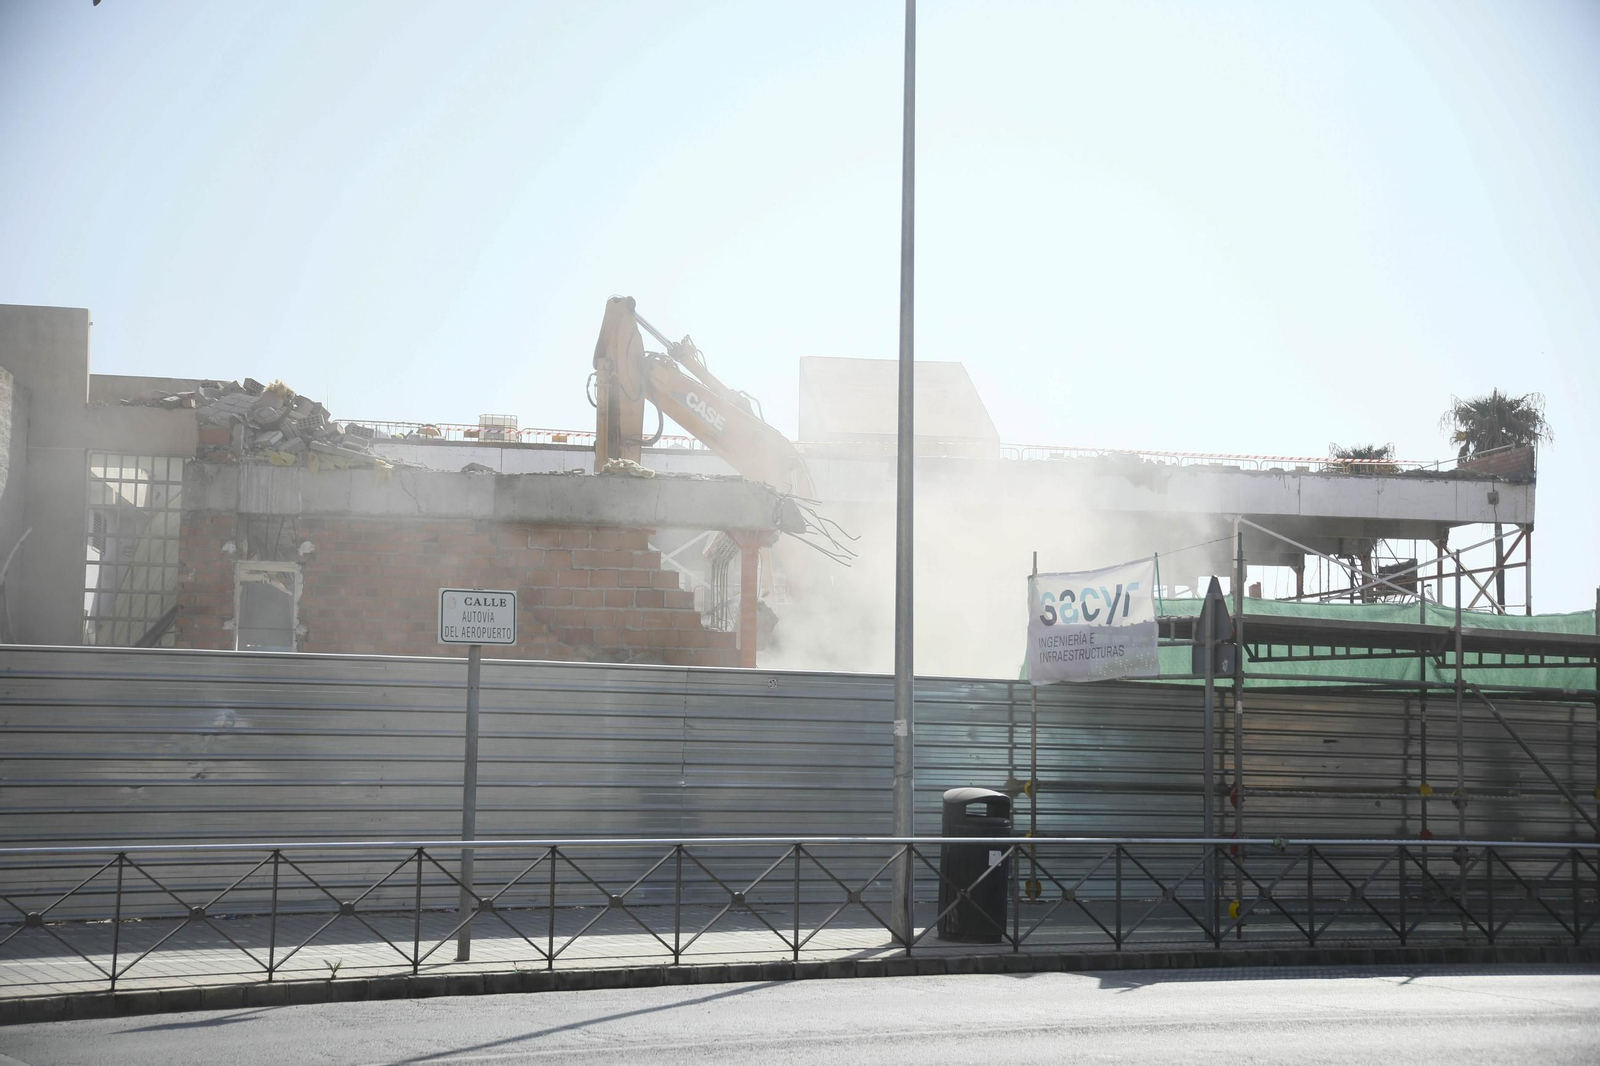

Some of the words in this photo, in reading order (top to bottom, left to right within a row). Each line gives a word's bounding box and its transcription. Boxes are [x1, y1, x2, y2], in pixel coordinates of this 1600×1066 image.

[686, 391, 726, 432] CASE
[464, 597, 507, 607] CALLE
[1040, 582, 1139, 626] sacyr
[462, 609, 495, 623] AUTOVÍA
[445, 626, 459, 638] DEL
[461, 627, 512, 640] AEROPUERTO
[1038, 631, 1087, 648] INGENIERÍA
[1089, 633, 1095, 645] E
[1040, 645, 1125, 663] INFRAESTRUCTURAS
